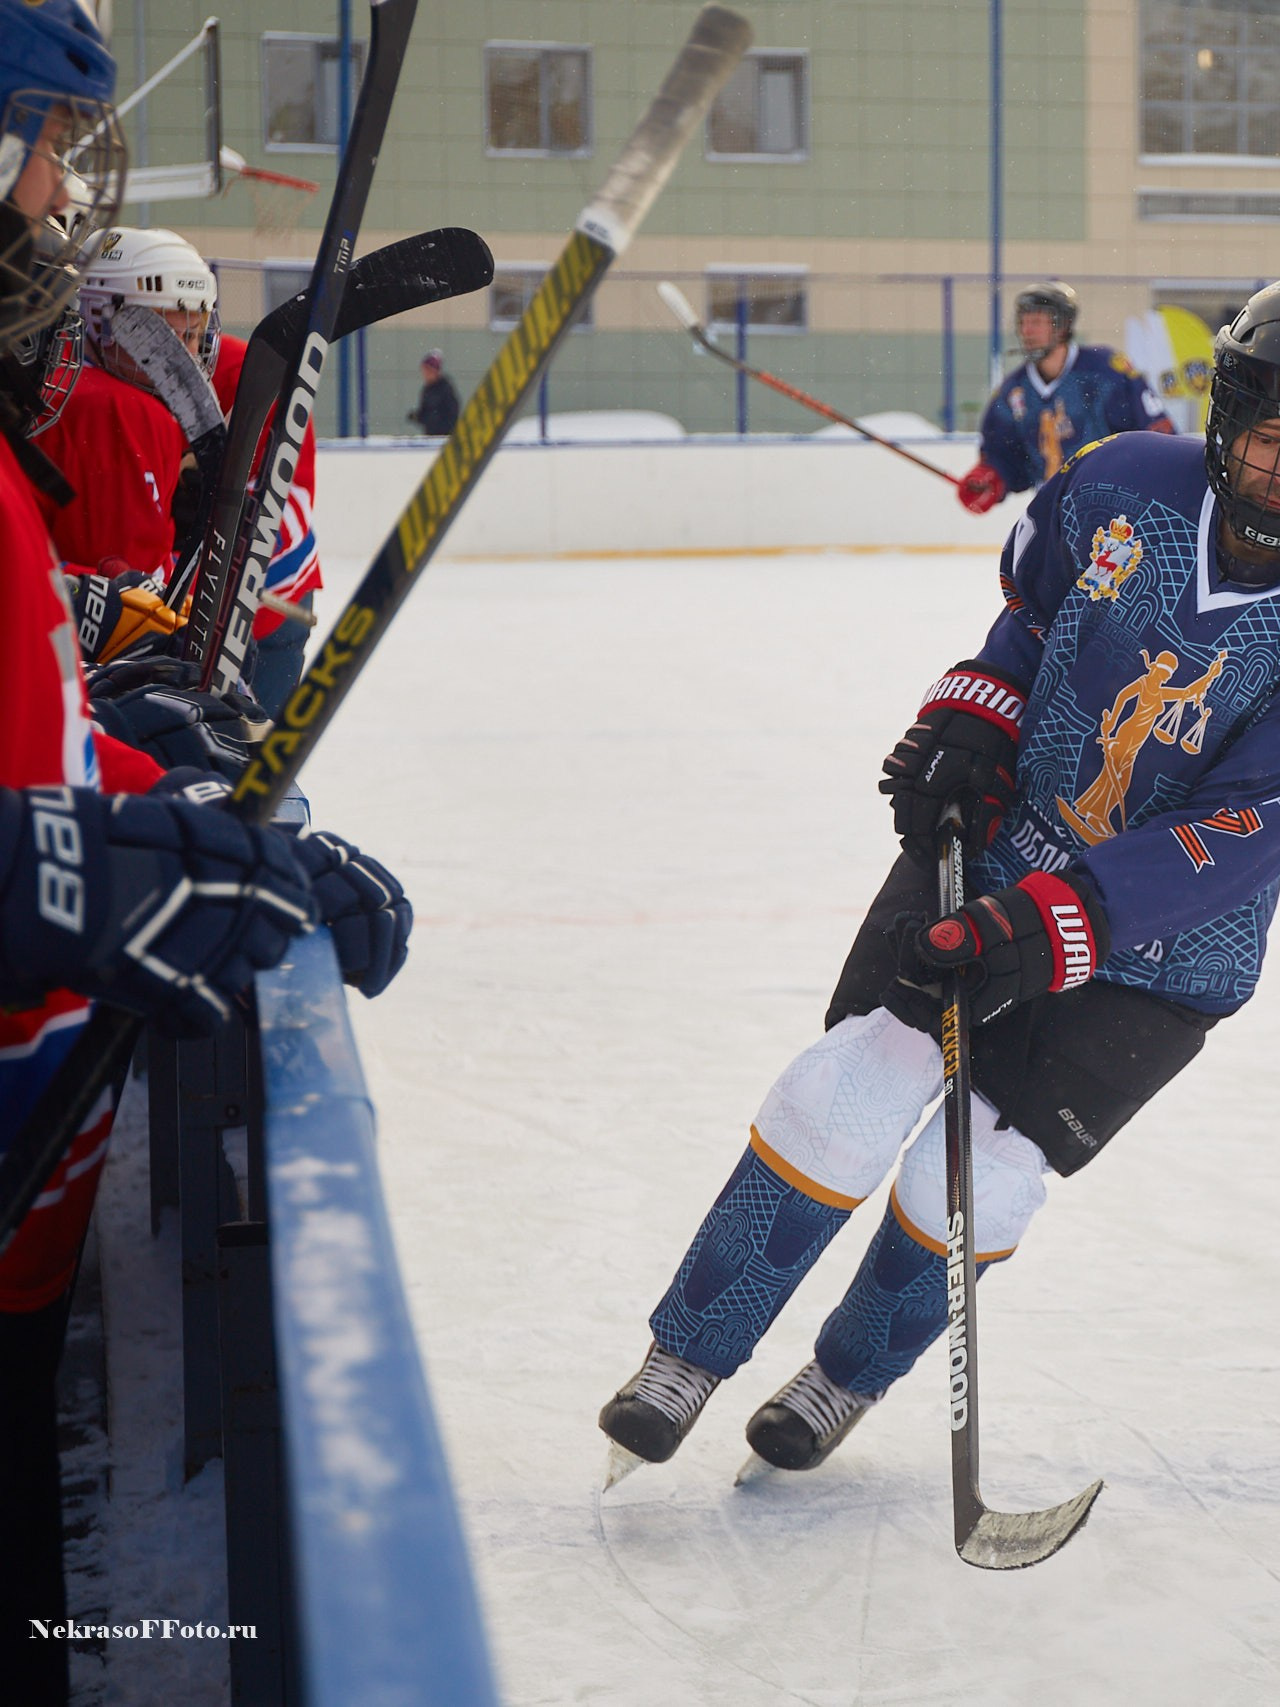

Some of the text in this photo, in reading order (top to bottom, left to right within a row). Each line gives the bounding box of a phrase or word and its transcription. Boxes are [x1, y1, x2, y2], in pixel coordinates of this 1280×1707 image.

[189, 528, 227, 661] FLYLITE
[210, 331, 330, 699] HERWOOD
[231, 603, 376, 804] TACKS
[920, 674, 1026, 728] ARRIO
